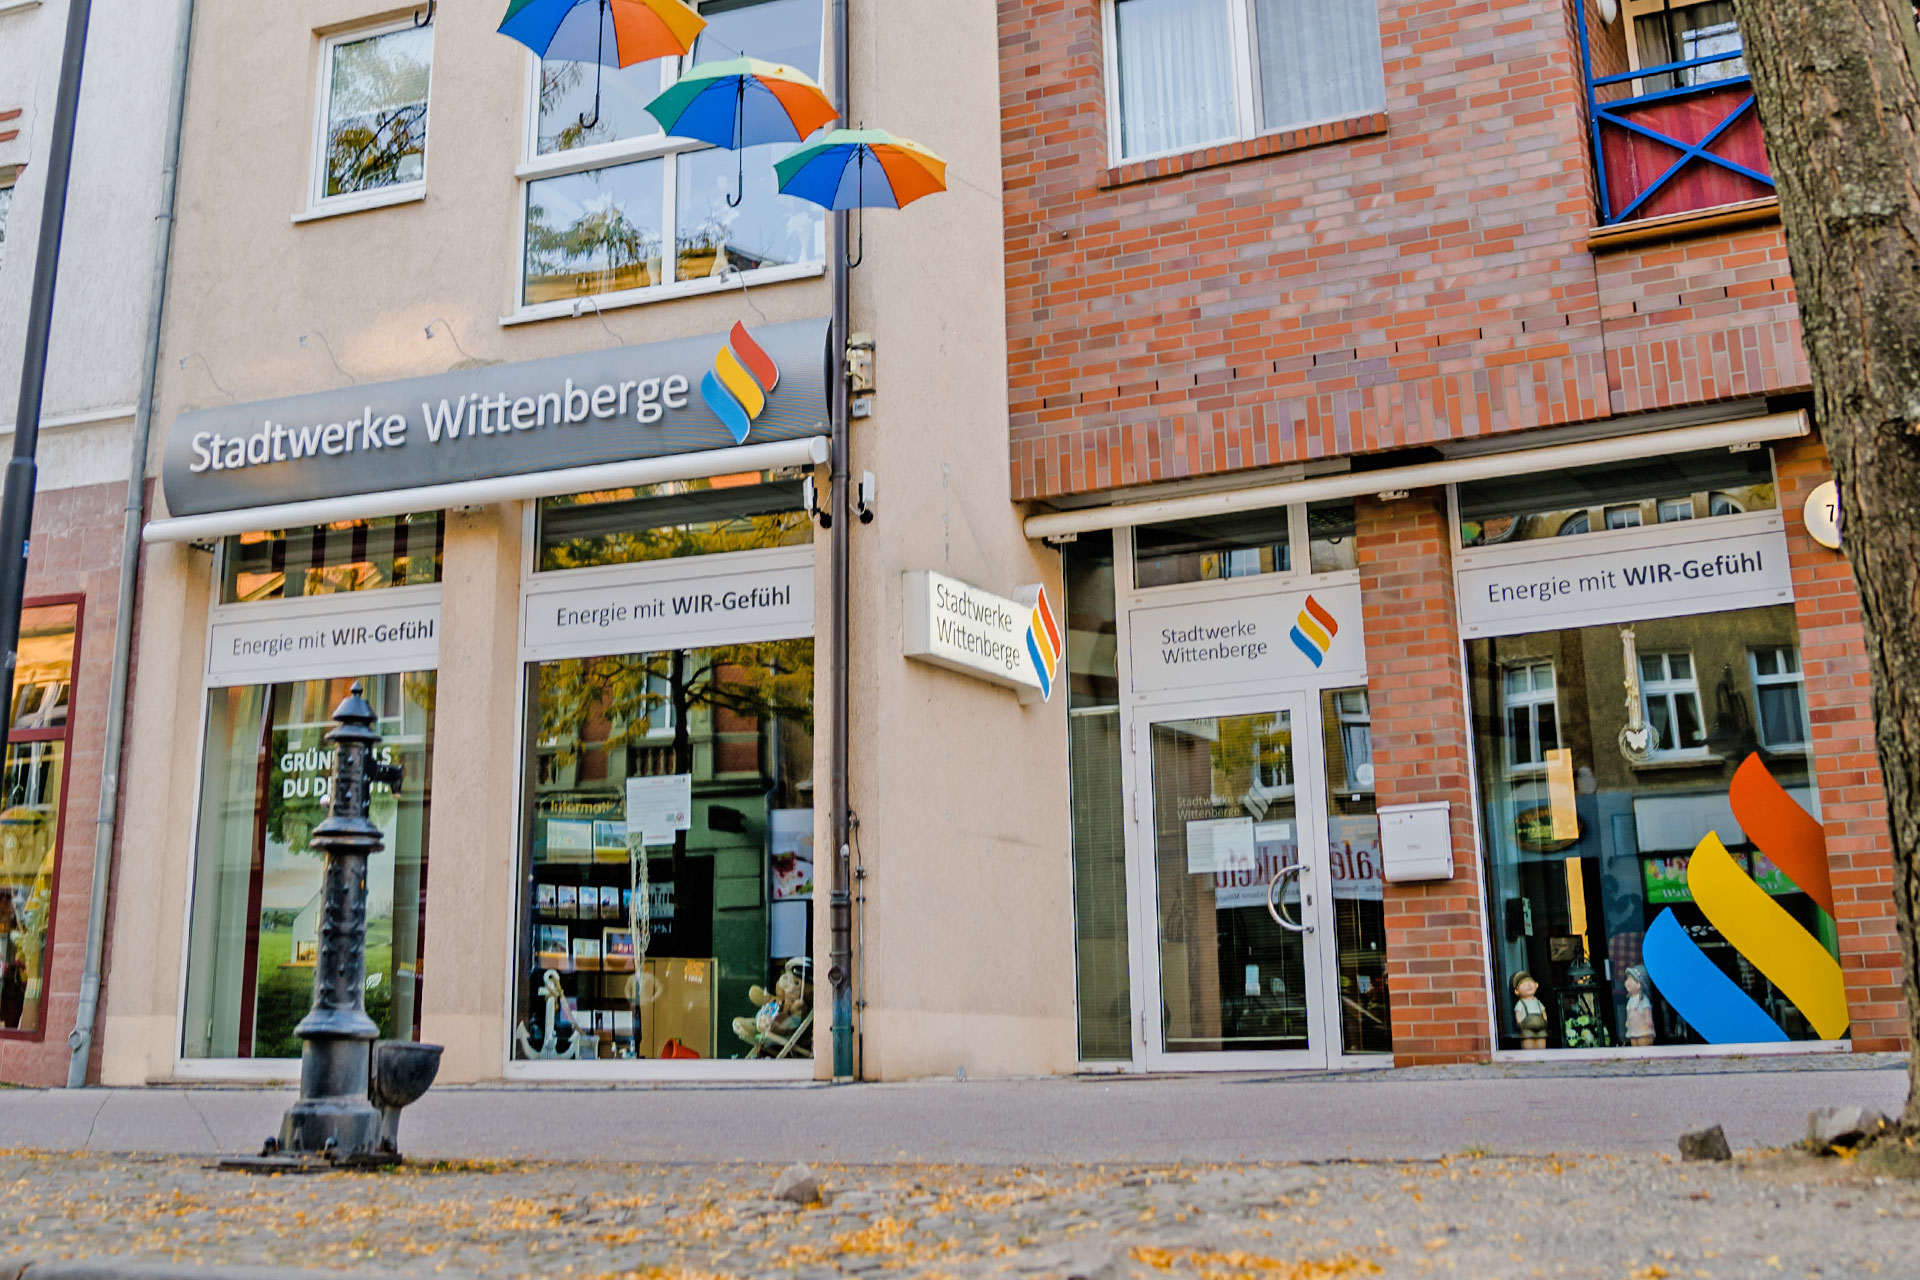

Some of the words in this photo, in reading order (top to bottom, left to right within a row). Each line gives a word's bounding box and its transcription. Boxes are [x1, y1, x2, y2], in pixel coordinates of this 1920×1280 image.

[189, 405, 407, 473] Stadtwerke
[421, 373, 689, 443] Wittenberge
[1488, 576, 1571, 603] Energie
[1578, 570, 1616, 592] mit
[1622, 550, 1763, 586] WIR-Gefühl
[556, 602, 627, 627] Energie
[633, 598, 666, 619] mit
[671, 585, 791, 616] WIR-Gefühl
[936, 583, 1012, 633] Stadtwerke
[232, 633, 293, 657] Energie
[298, 630, 327, 649] mit
[332, 618, 434, 646] WIR-Gefühl
[936, 616, 1020, 670] Wittenberge
[1161, 619, 1257, 645] Stadtwerke
[1161, 641, 1268, 665] Wittenberge
[282, 777, 310, 799] DU
[1177, 793, 1234, 809] Stadtwerke
[1177, 807, 1240, 820] Wittenberge
